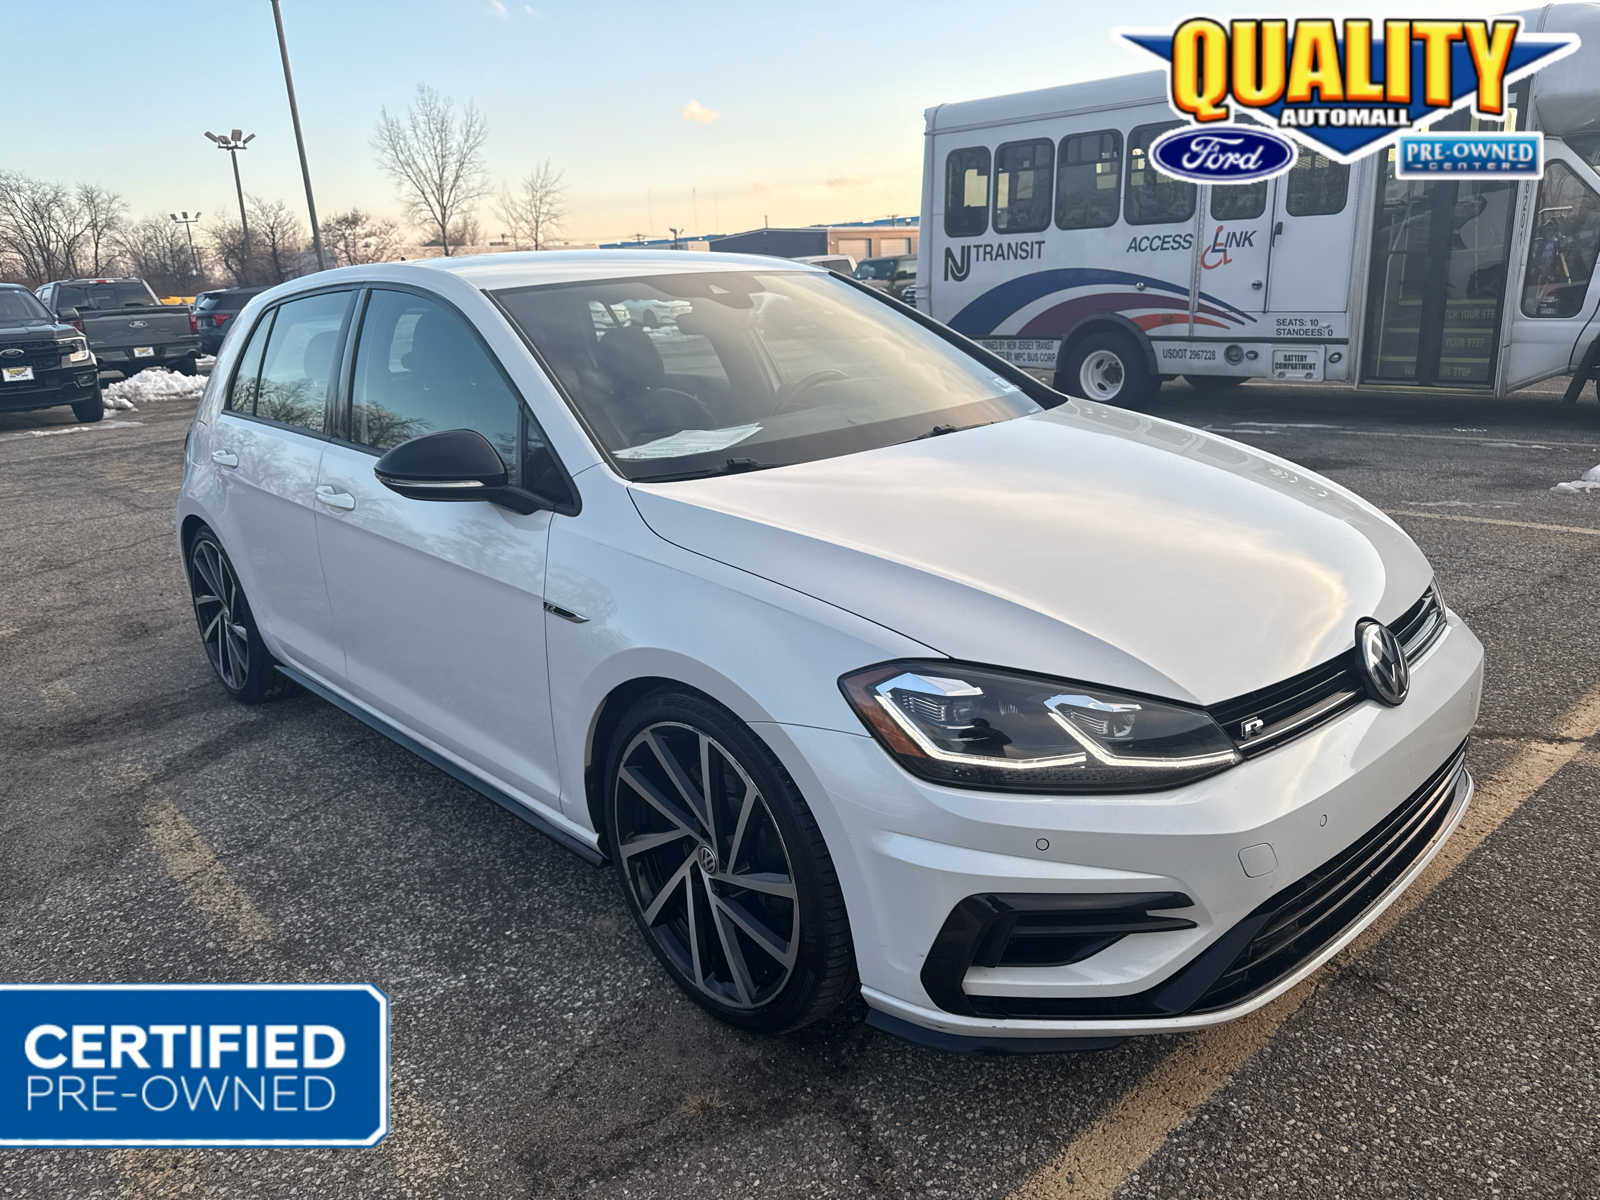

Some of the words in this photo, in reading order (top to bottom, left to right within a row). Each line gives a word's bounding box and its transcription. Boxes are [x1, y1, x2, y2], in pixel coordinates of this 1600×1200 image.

[1126, 232, 1194, 253] ACCESS
[1210, 229, 1257, 253] LINK
[943, 244, 972, 282] NJ
[972, 240, 1046, 262] TRANSIT
[1275, 318, 1308, 328] SEATS:
[1309, 319, 1319, 328] 10
[1275, 327, 1326, 337] STANDEES:
[1327, 329, 1334, 337] 0
[1162, 347, 1187, 359] USDOT
[1283, 354, 1308, 362] BATTERY
[1275, 362, 1317, 371] COMPARTMENT
[1240, 716, 1264, 740] R
